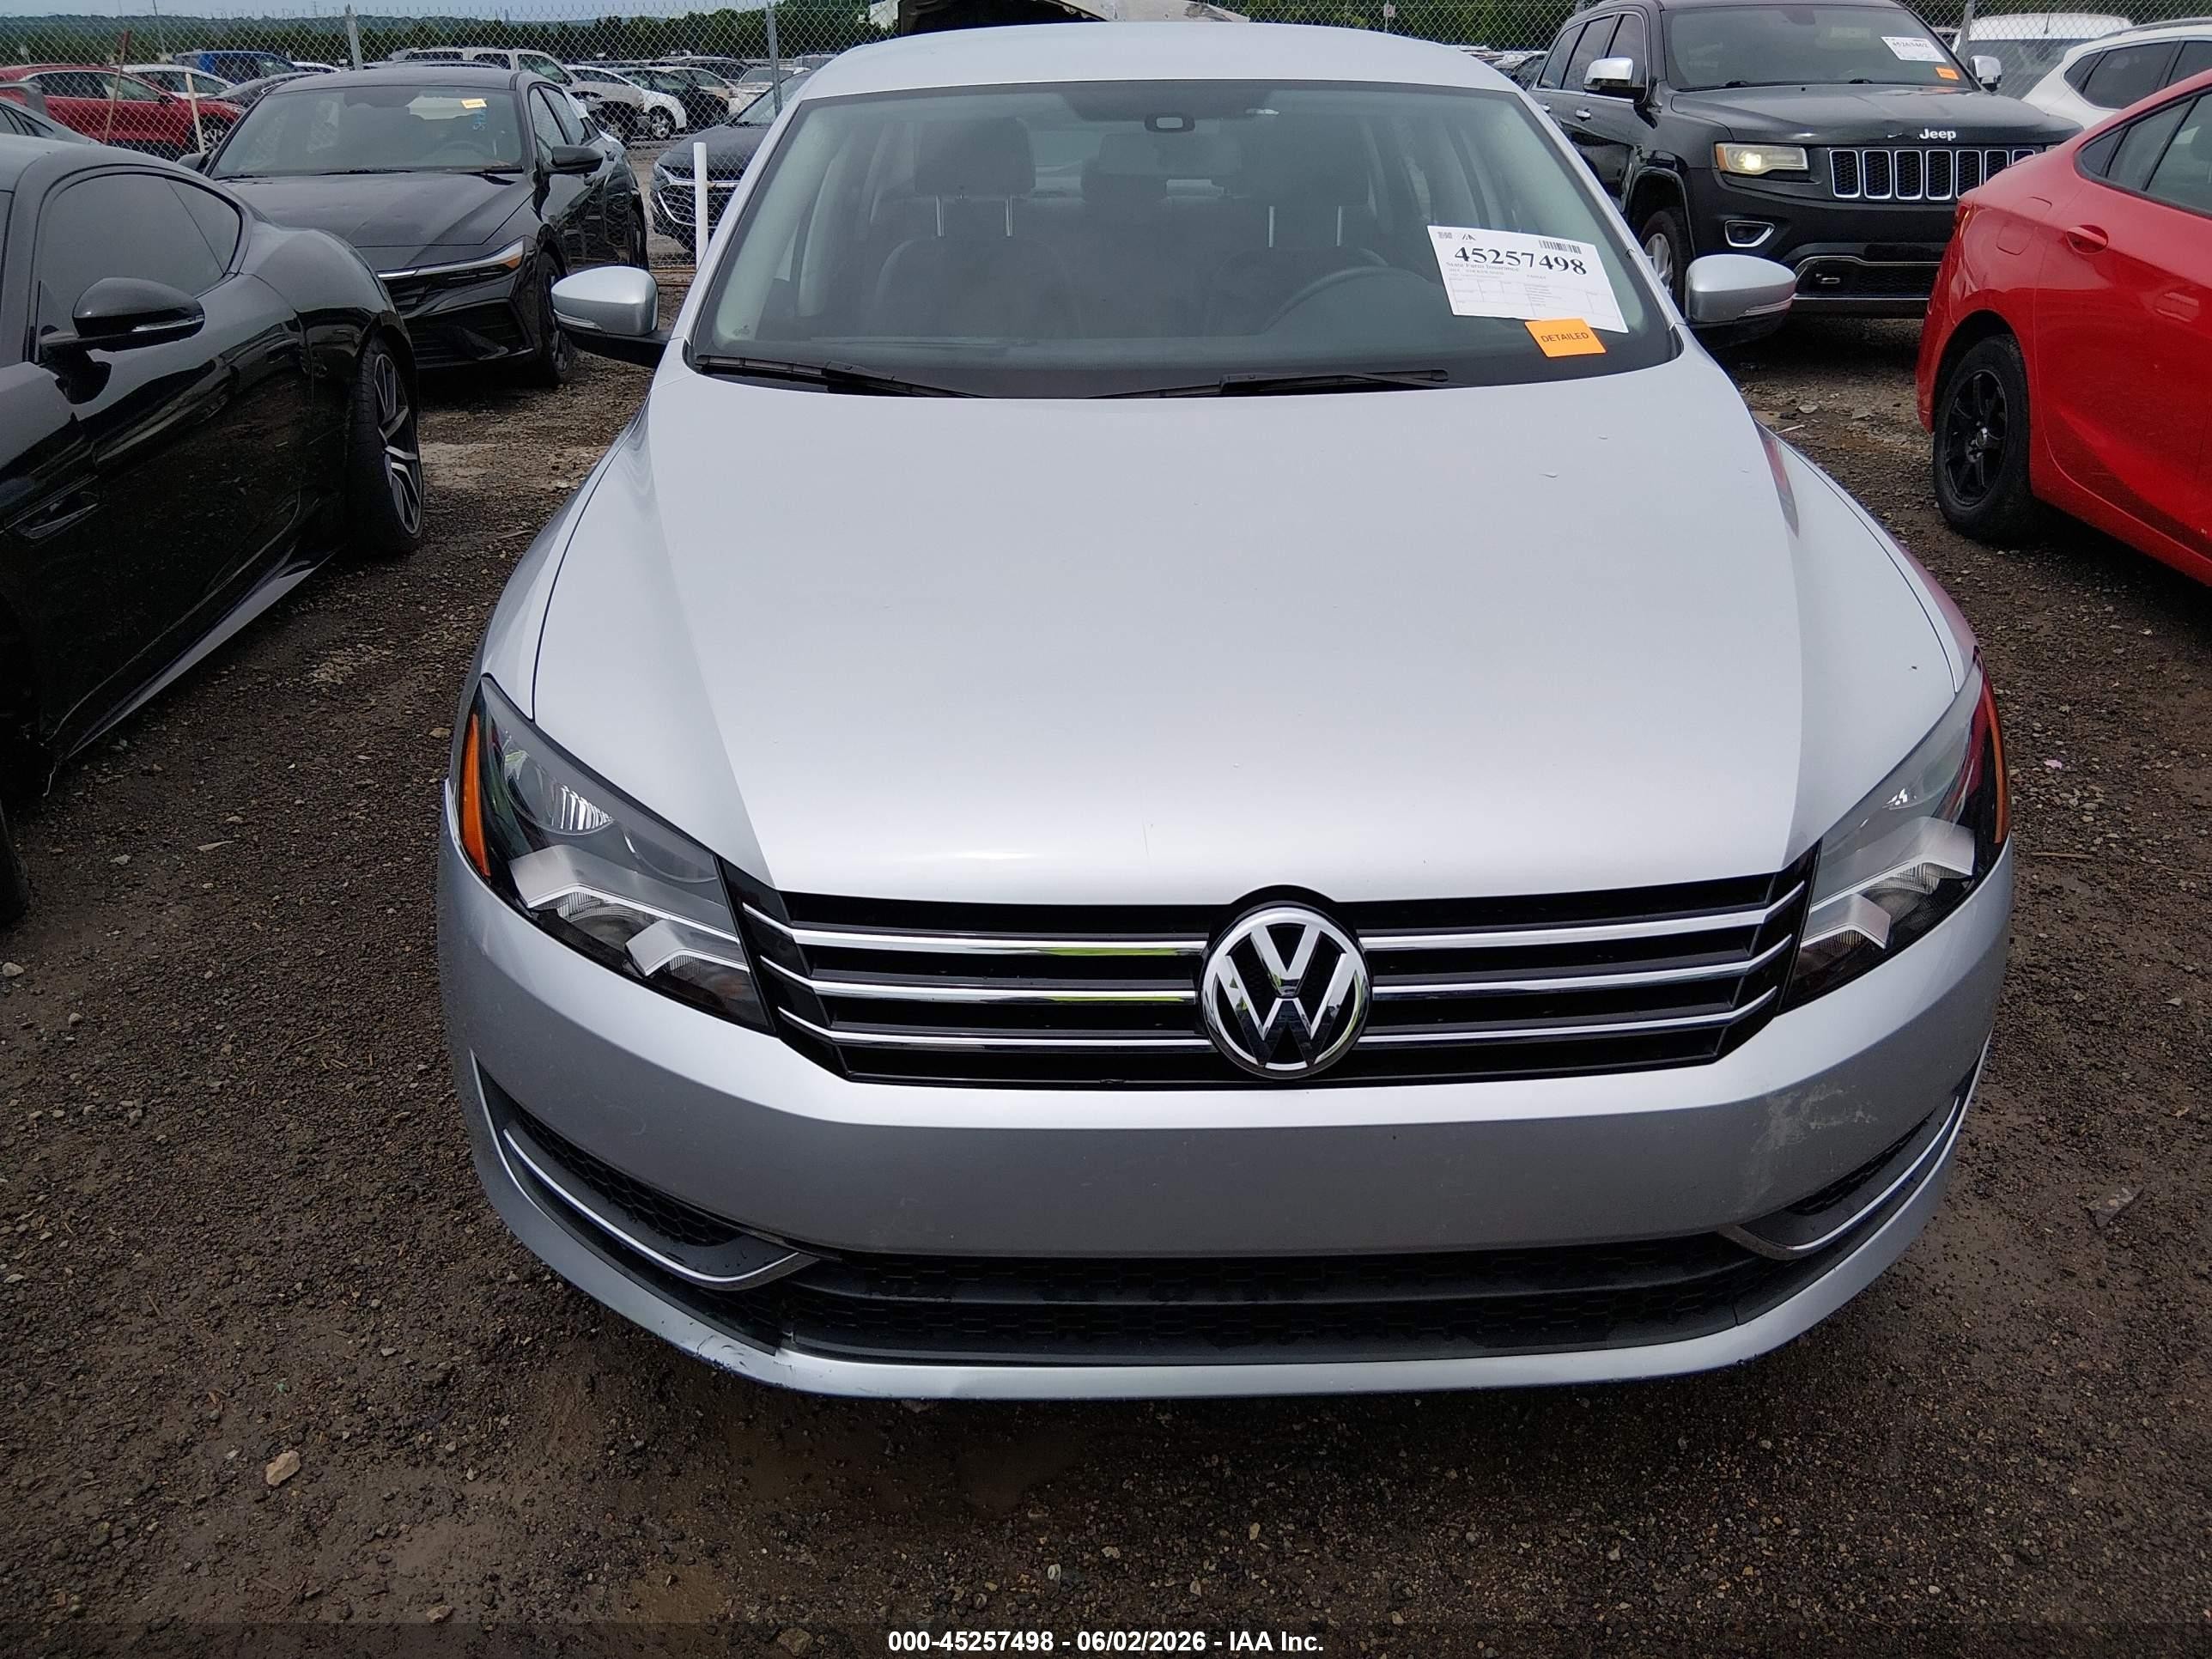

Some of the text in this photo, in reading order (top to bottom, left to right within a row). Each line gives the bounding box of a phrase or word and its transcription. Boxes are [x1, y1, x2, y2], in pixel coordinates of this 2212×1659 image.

[1919, 128, 1957, 141] Jeep
[1454, 246, 1587, 275] 45257498
[1540, 332, 1589, 343] DETAILED
